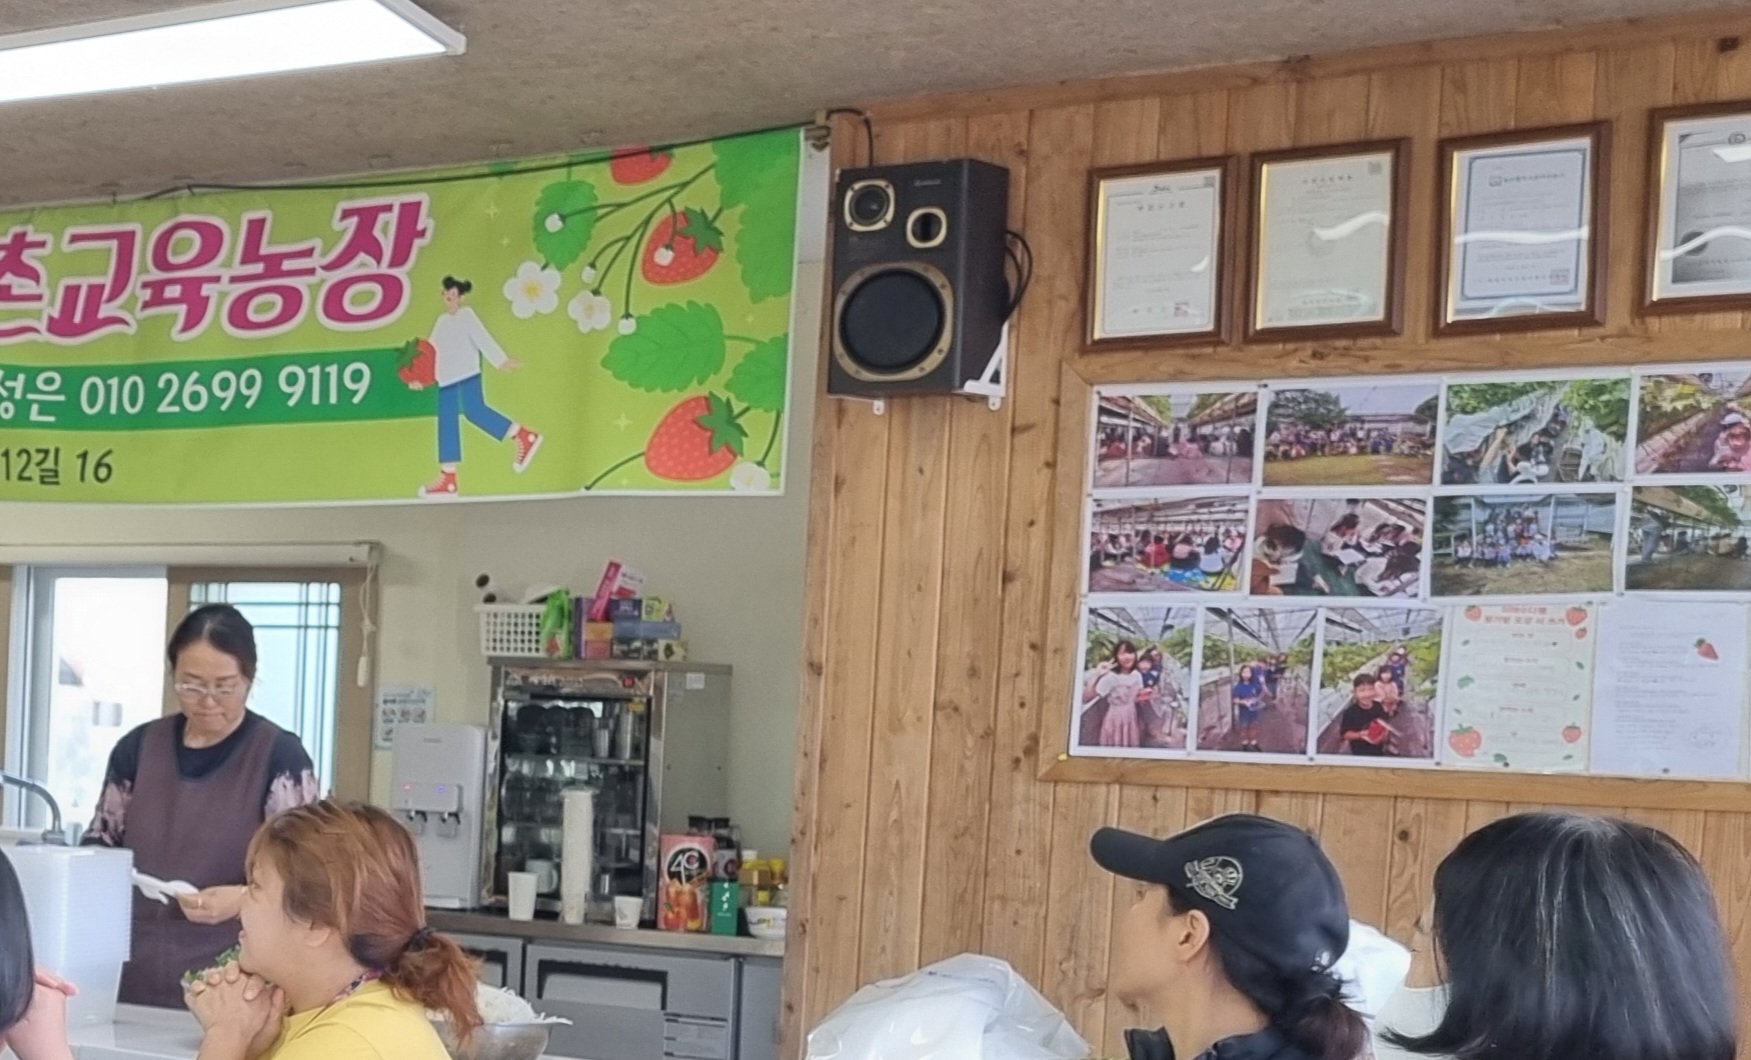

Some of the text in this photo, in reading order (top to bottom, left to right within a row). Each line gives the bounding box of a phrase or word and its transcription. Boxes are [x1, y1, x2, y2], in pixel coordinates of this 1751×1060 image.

[79, 375, 145, 415] 010
[156, 367, 263, 413] 2699
[277, 361, 371, 408] 9119
[75, 448, 114, 484] 16
